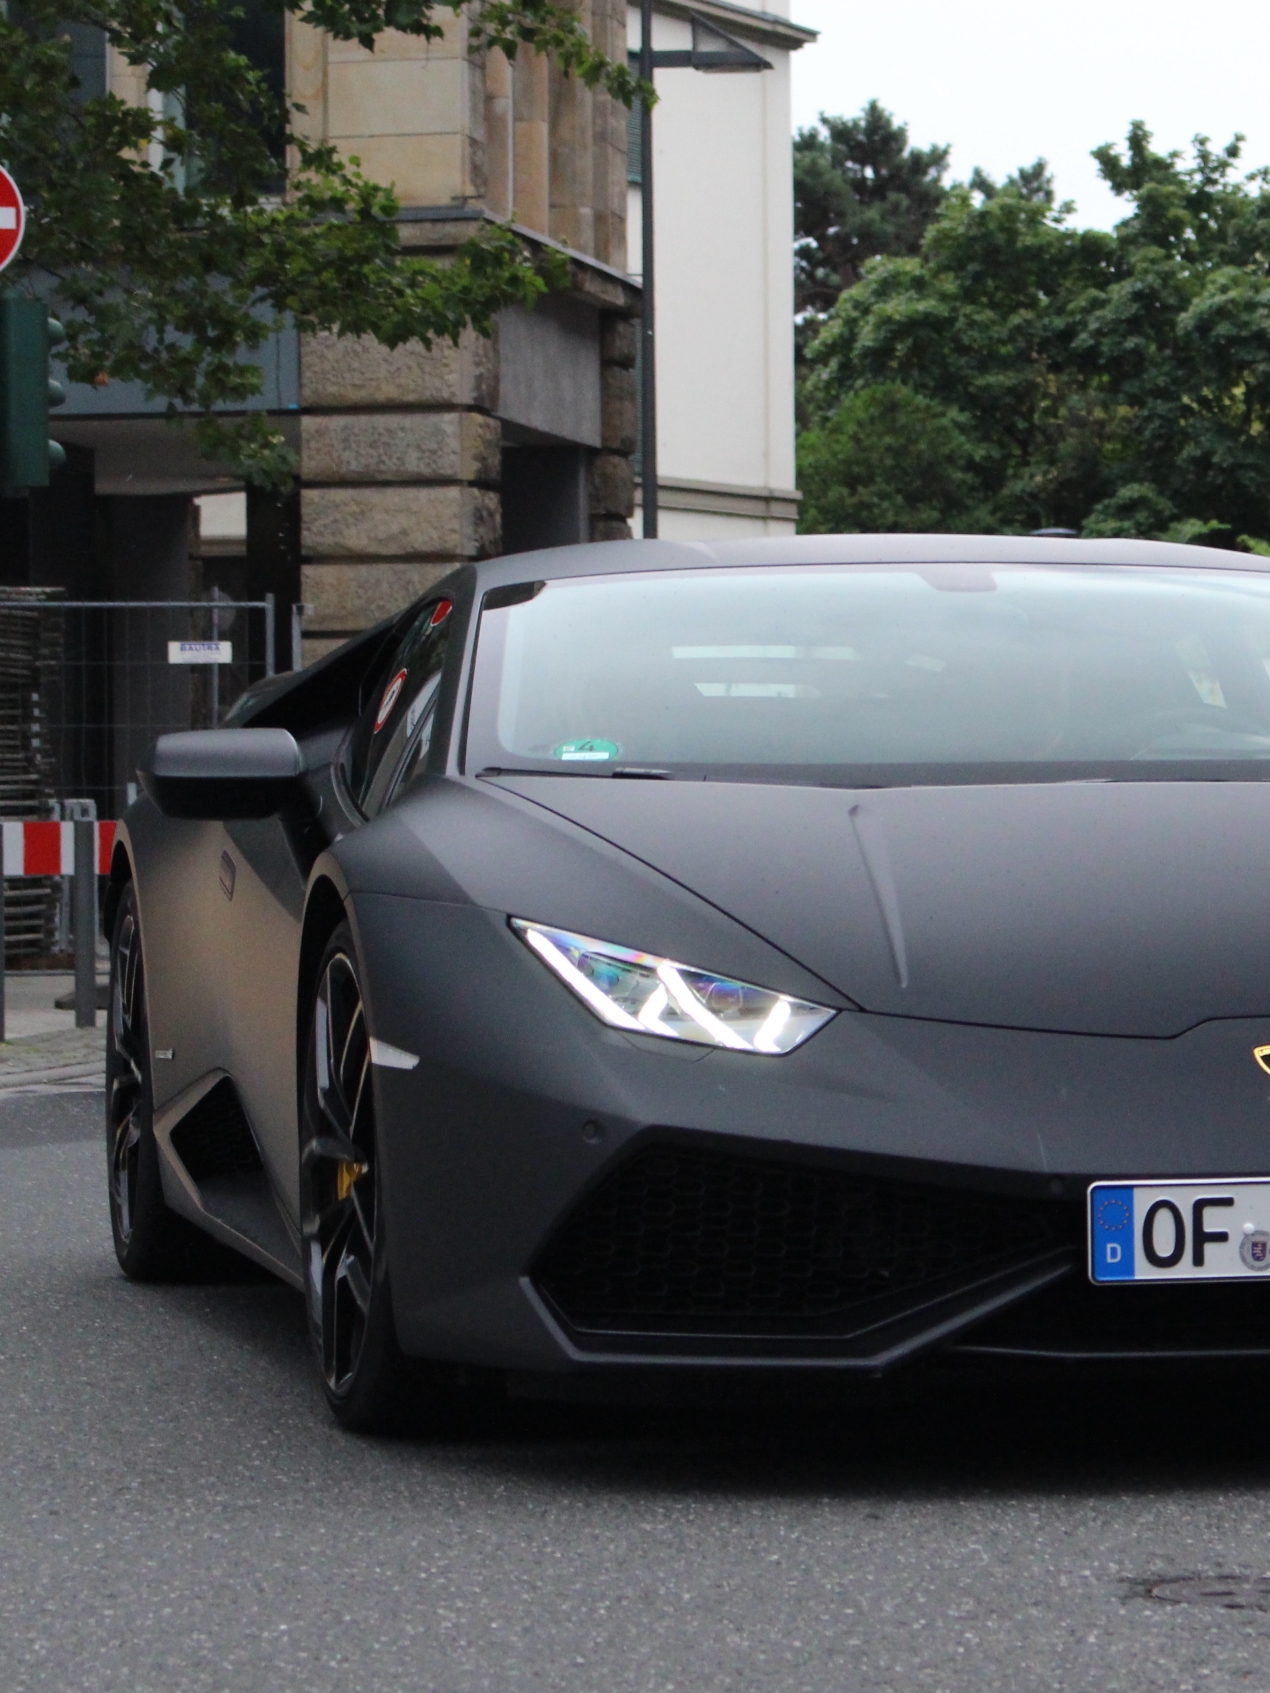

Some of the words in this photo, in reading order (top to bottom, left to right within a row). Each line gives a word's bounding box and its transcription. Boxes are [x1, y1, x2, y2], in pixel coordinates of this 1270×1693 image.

[578, 740, 595, 752] 4
[1142, 1196, 1235, 1269] OF
[1106, 1243, 1121, 1263] D
